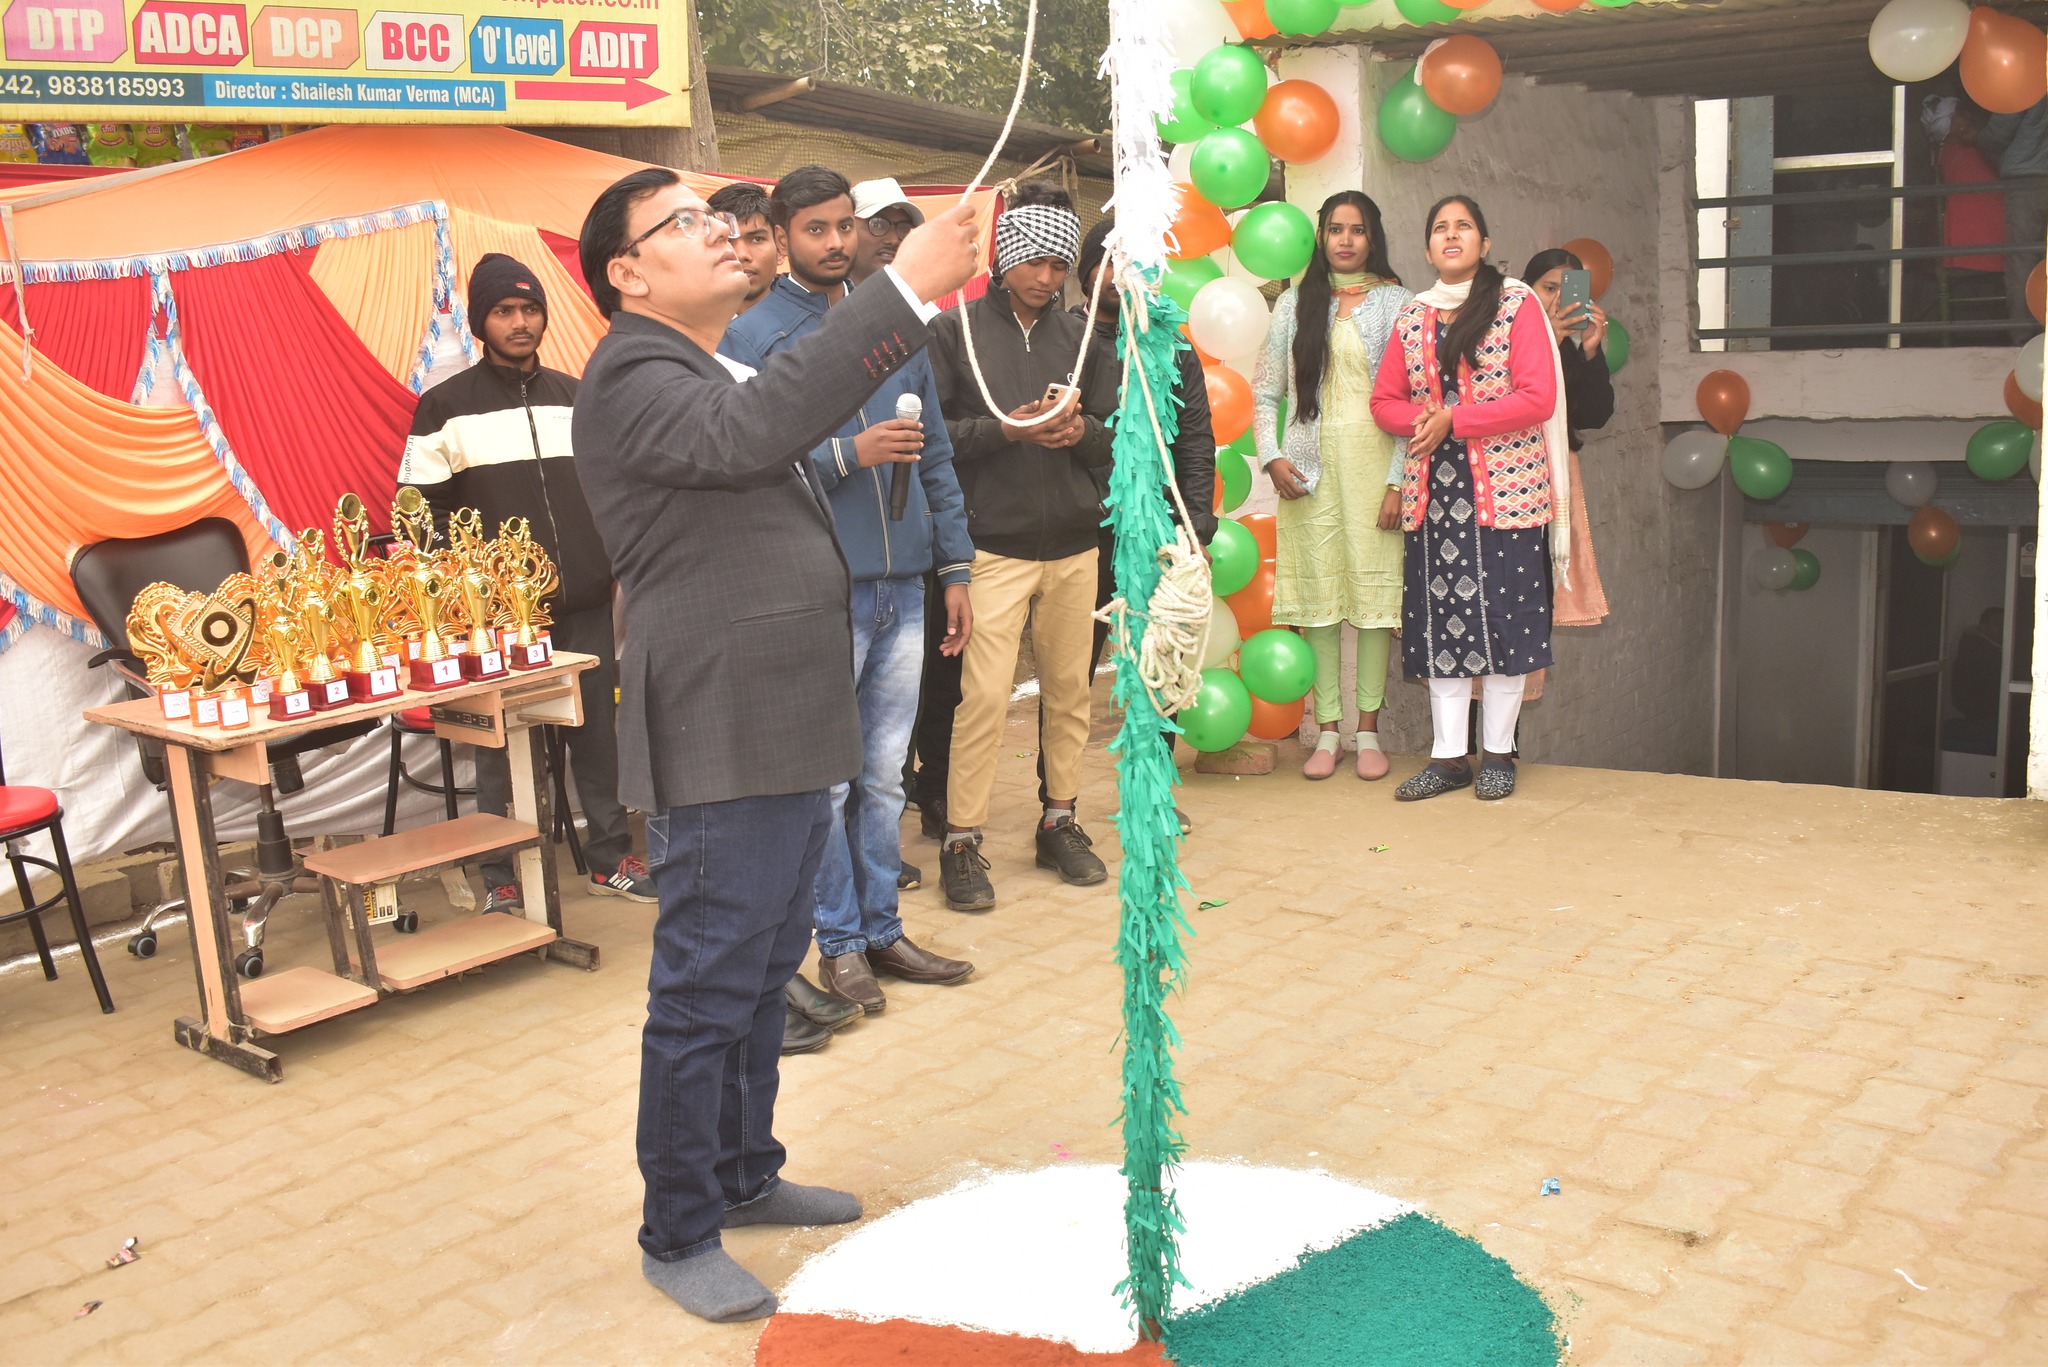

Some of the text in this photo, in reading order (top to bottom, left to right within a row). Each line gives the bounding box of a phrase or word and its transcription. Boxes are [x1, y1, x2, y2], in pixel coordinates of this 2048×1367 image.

[26, 7, 104, 51] DTP
[140, 11, 244, 56] ADCA
[270, 16, 343, 59] DCP
[381, 21, 450, 62] BCC
[477, 25, 557, 66] 'O' Level
[579, 30, 647, 69] ADIT
[48, 75, 185, 98] 9838185993
[215, 80, 277, 100] Director
[291, 82, 353, 101] Shailesh
[357, 84, 402, 102] Kumar
[406, 85, 450, 103] Verma
[454, 86, 495, 108] (MCA)
[488, 657, 494, 666] 2
[533, 649, 539, 658] 3
[379, 675, 385, 686] 1
[442, 665, 449, 676] 1
[294, 698, 300, 707] 3
[334, 686, 340, 695] 2
